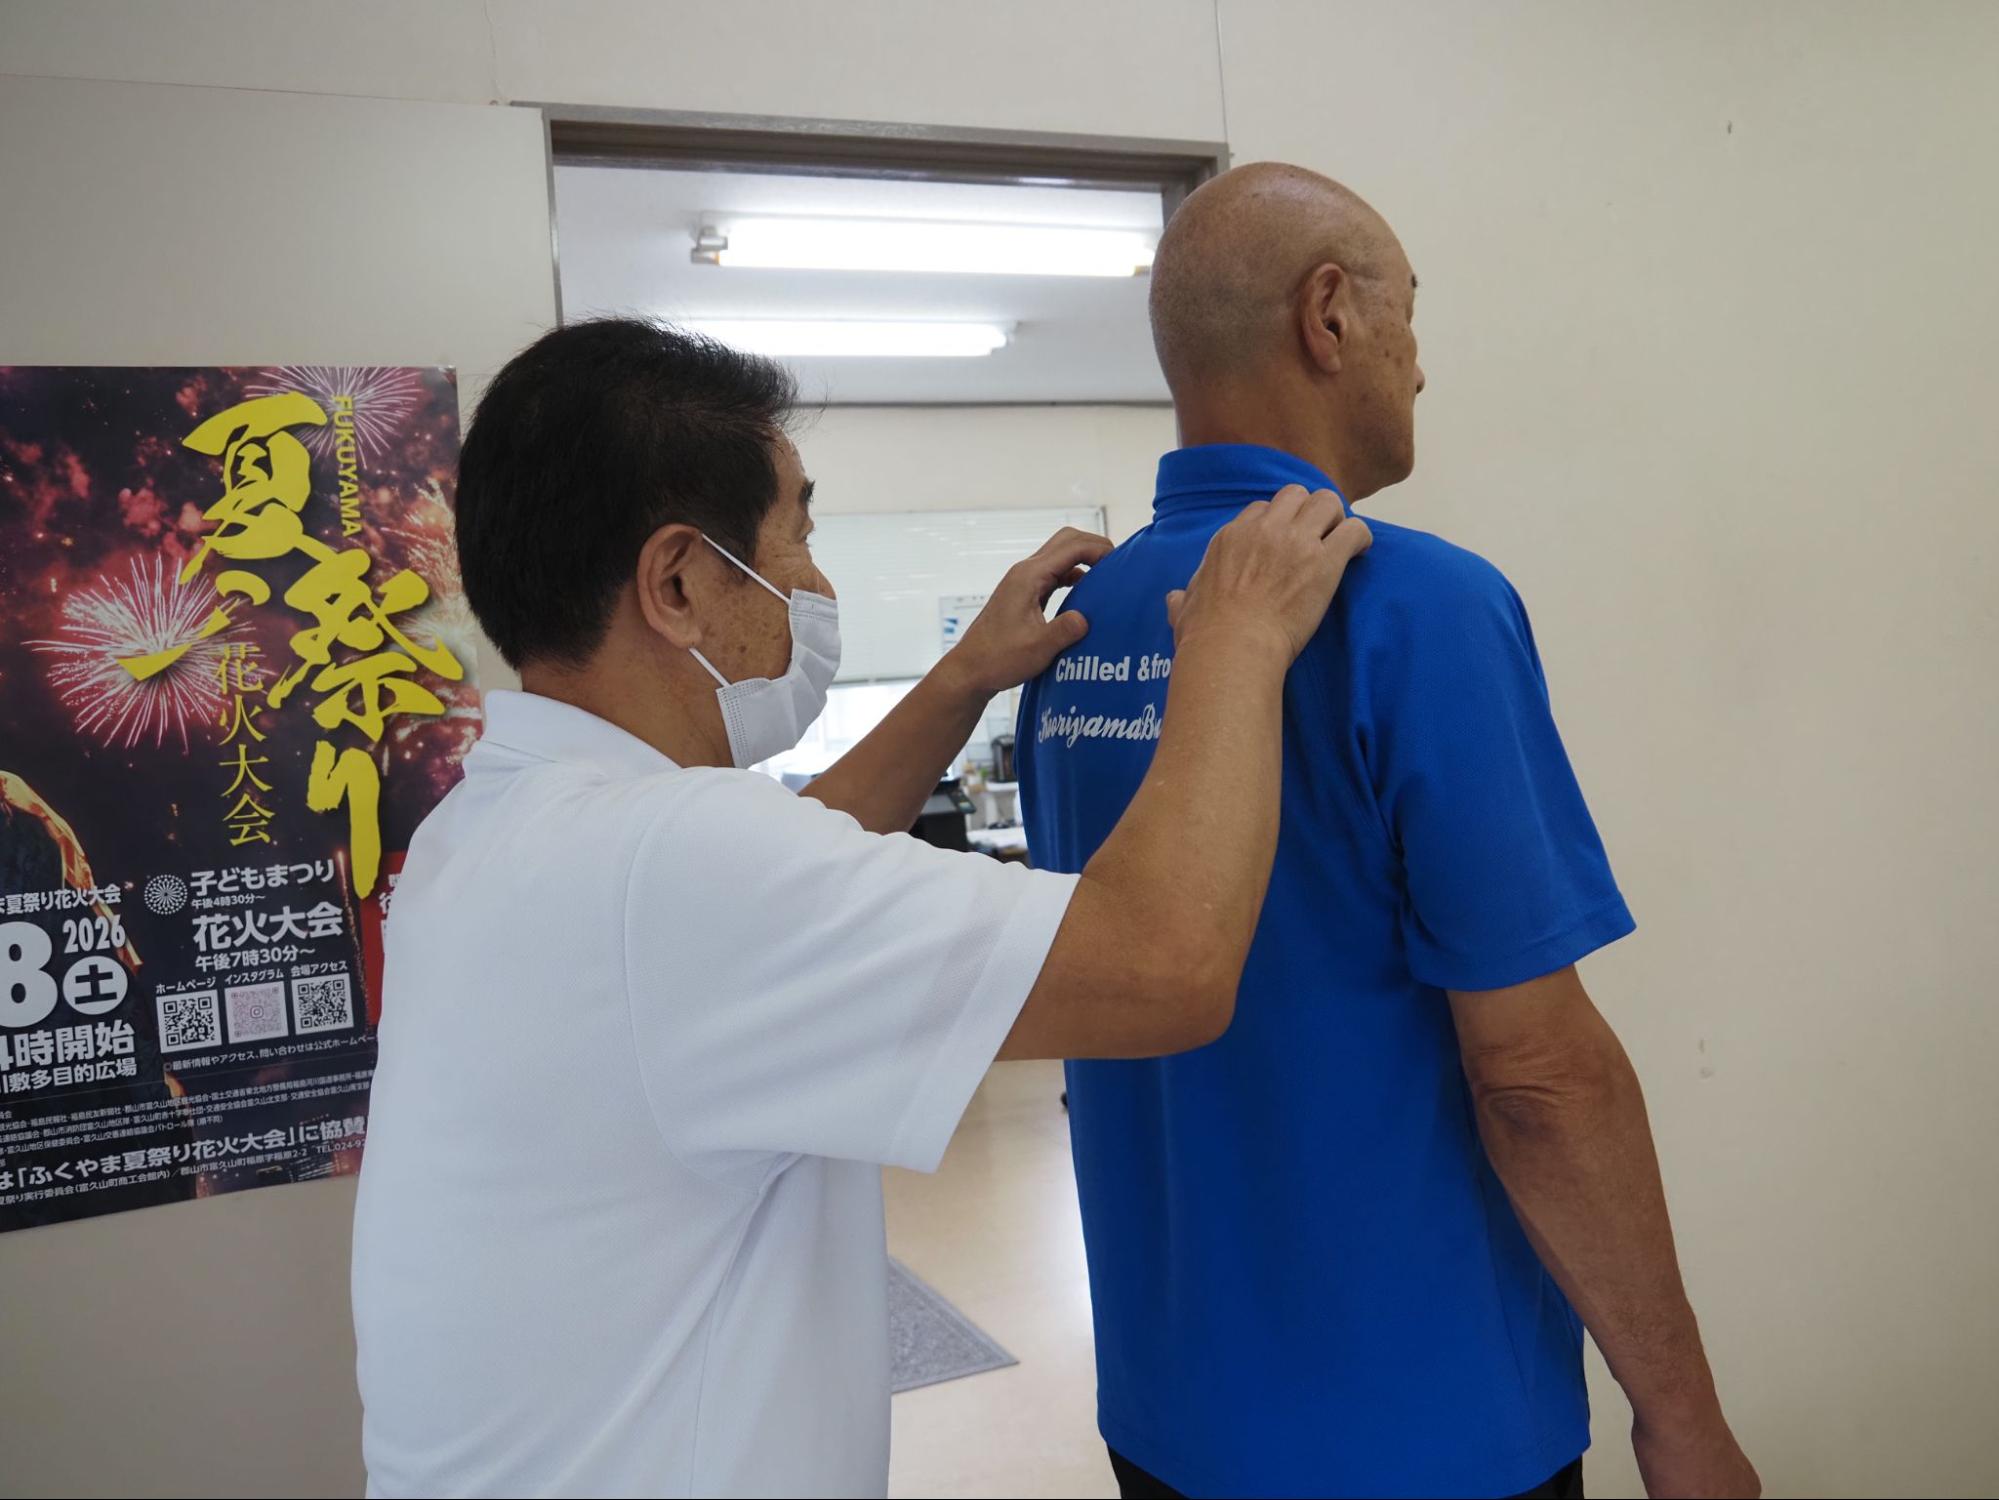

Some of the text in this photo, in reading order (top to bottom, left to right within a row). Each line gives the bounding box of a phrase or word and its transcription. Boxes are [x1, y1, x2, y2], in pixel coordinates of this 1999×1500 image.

[333, 395, 361, 538] FUKUYAMA
[1055, 653, 1172, 682] Chilled &fro
[213, 644, 276, 848] 花火大会
[190, 859, 335, 897] 子どもまつり
[62, 914, 126, 954] 2026
[192, 901, 344, 952] 花火大会
[0, 921, 58, 1028] 8
[70, 960, 123, 1010] 土
[155, 976, 217, 994] ホームページ
[224, 968, 285, 985] インスタグラム
[290, 960, 349, 977] 会場アクセス
